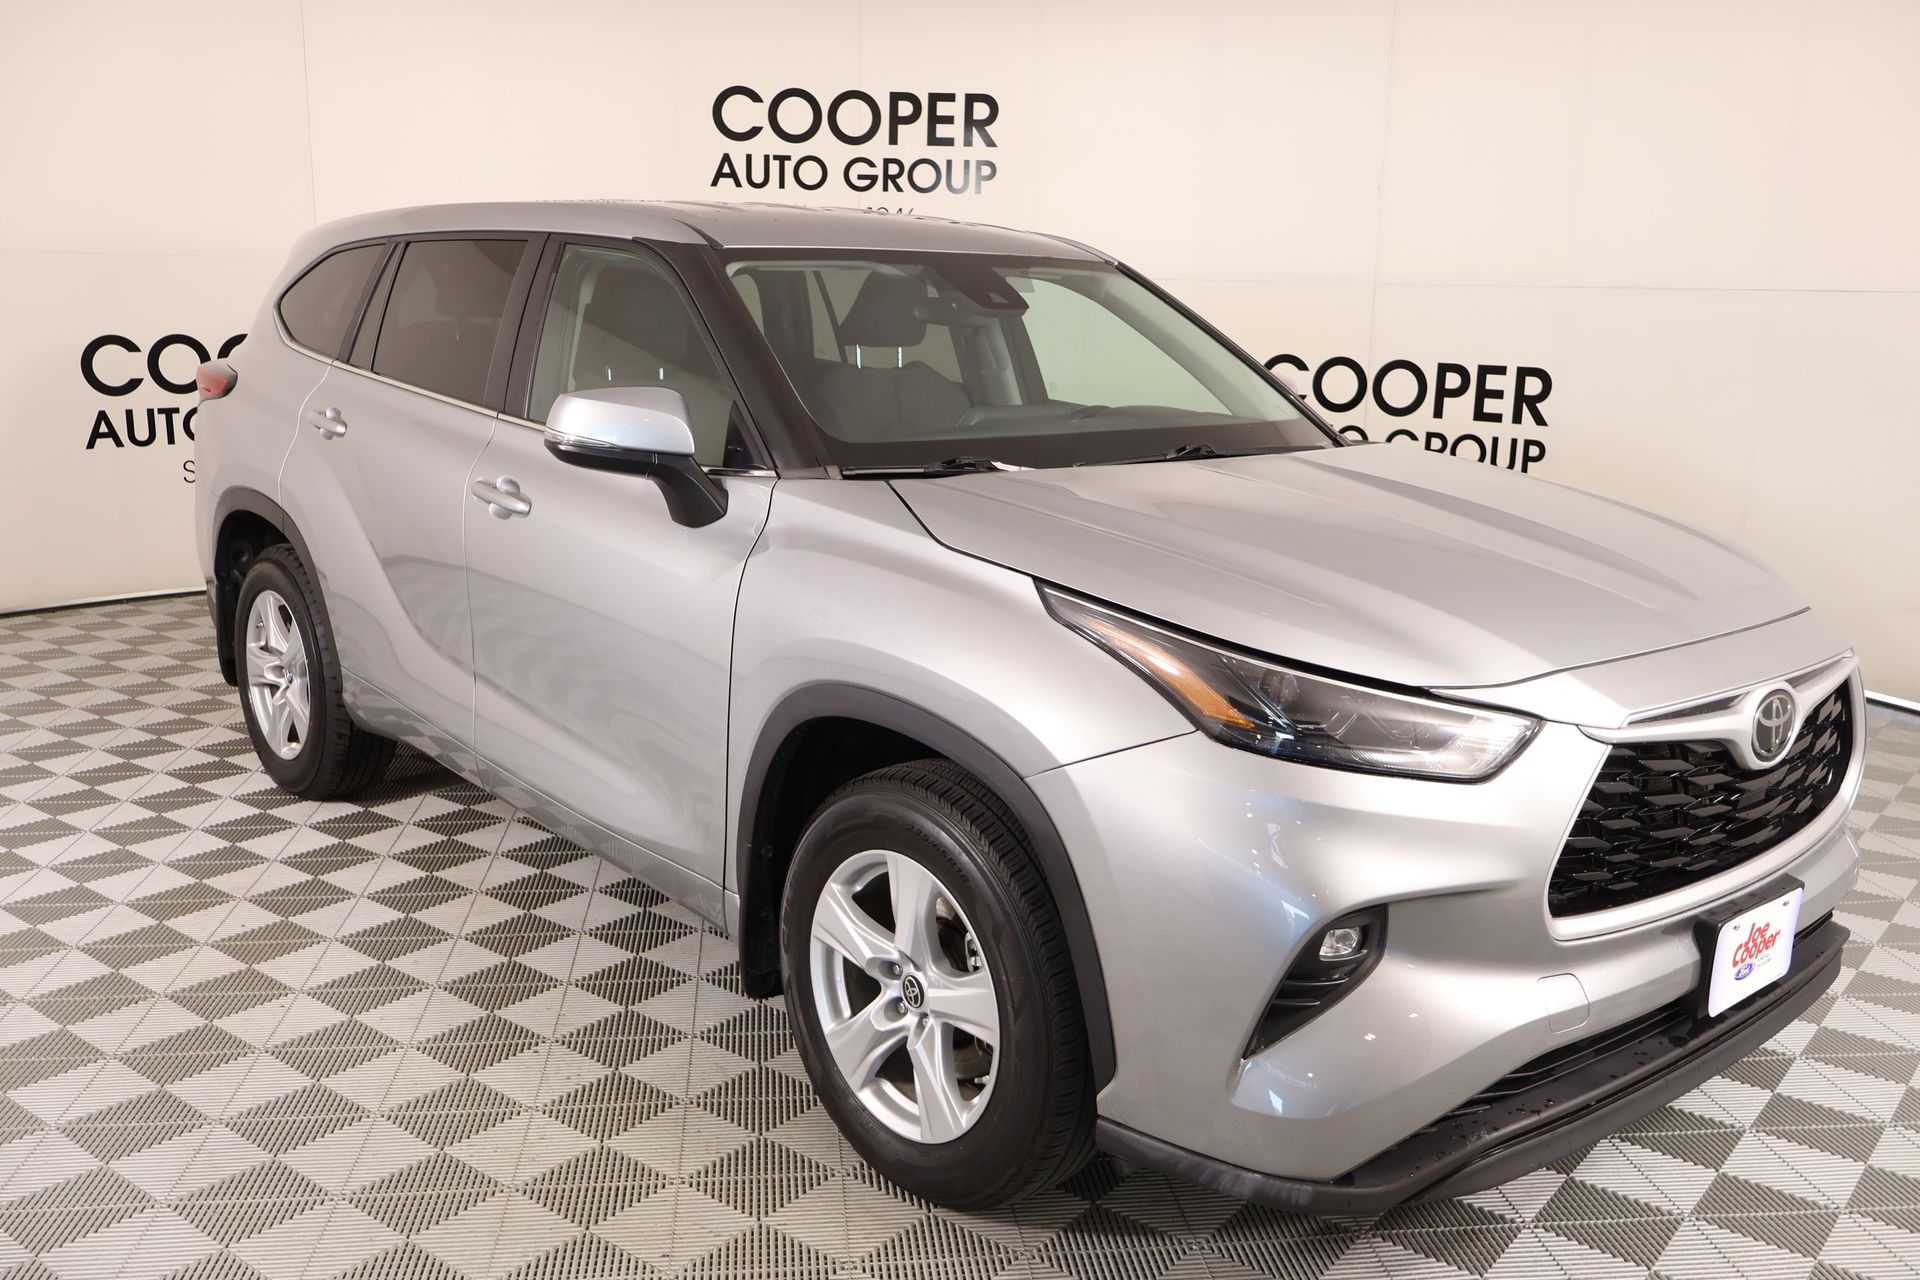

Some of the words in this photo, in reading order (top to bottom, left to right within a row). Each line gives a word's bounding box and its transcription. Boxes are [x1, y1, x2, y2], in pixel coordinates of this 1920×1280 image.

[712, 85, 1000, 147] COOPER
[710, 153, 828, 191] AUTO
[843, 157, 997, 194] GROUP
[1732, 930, 1781, 968] Cooper
[1744, 922, 1770, 947] Joe
